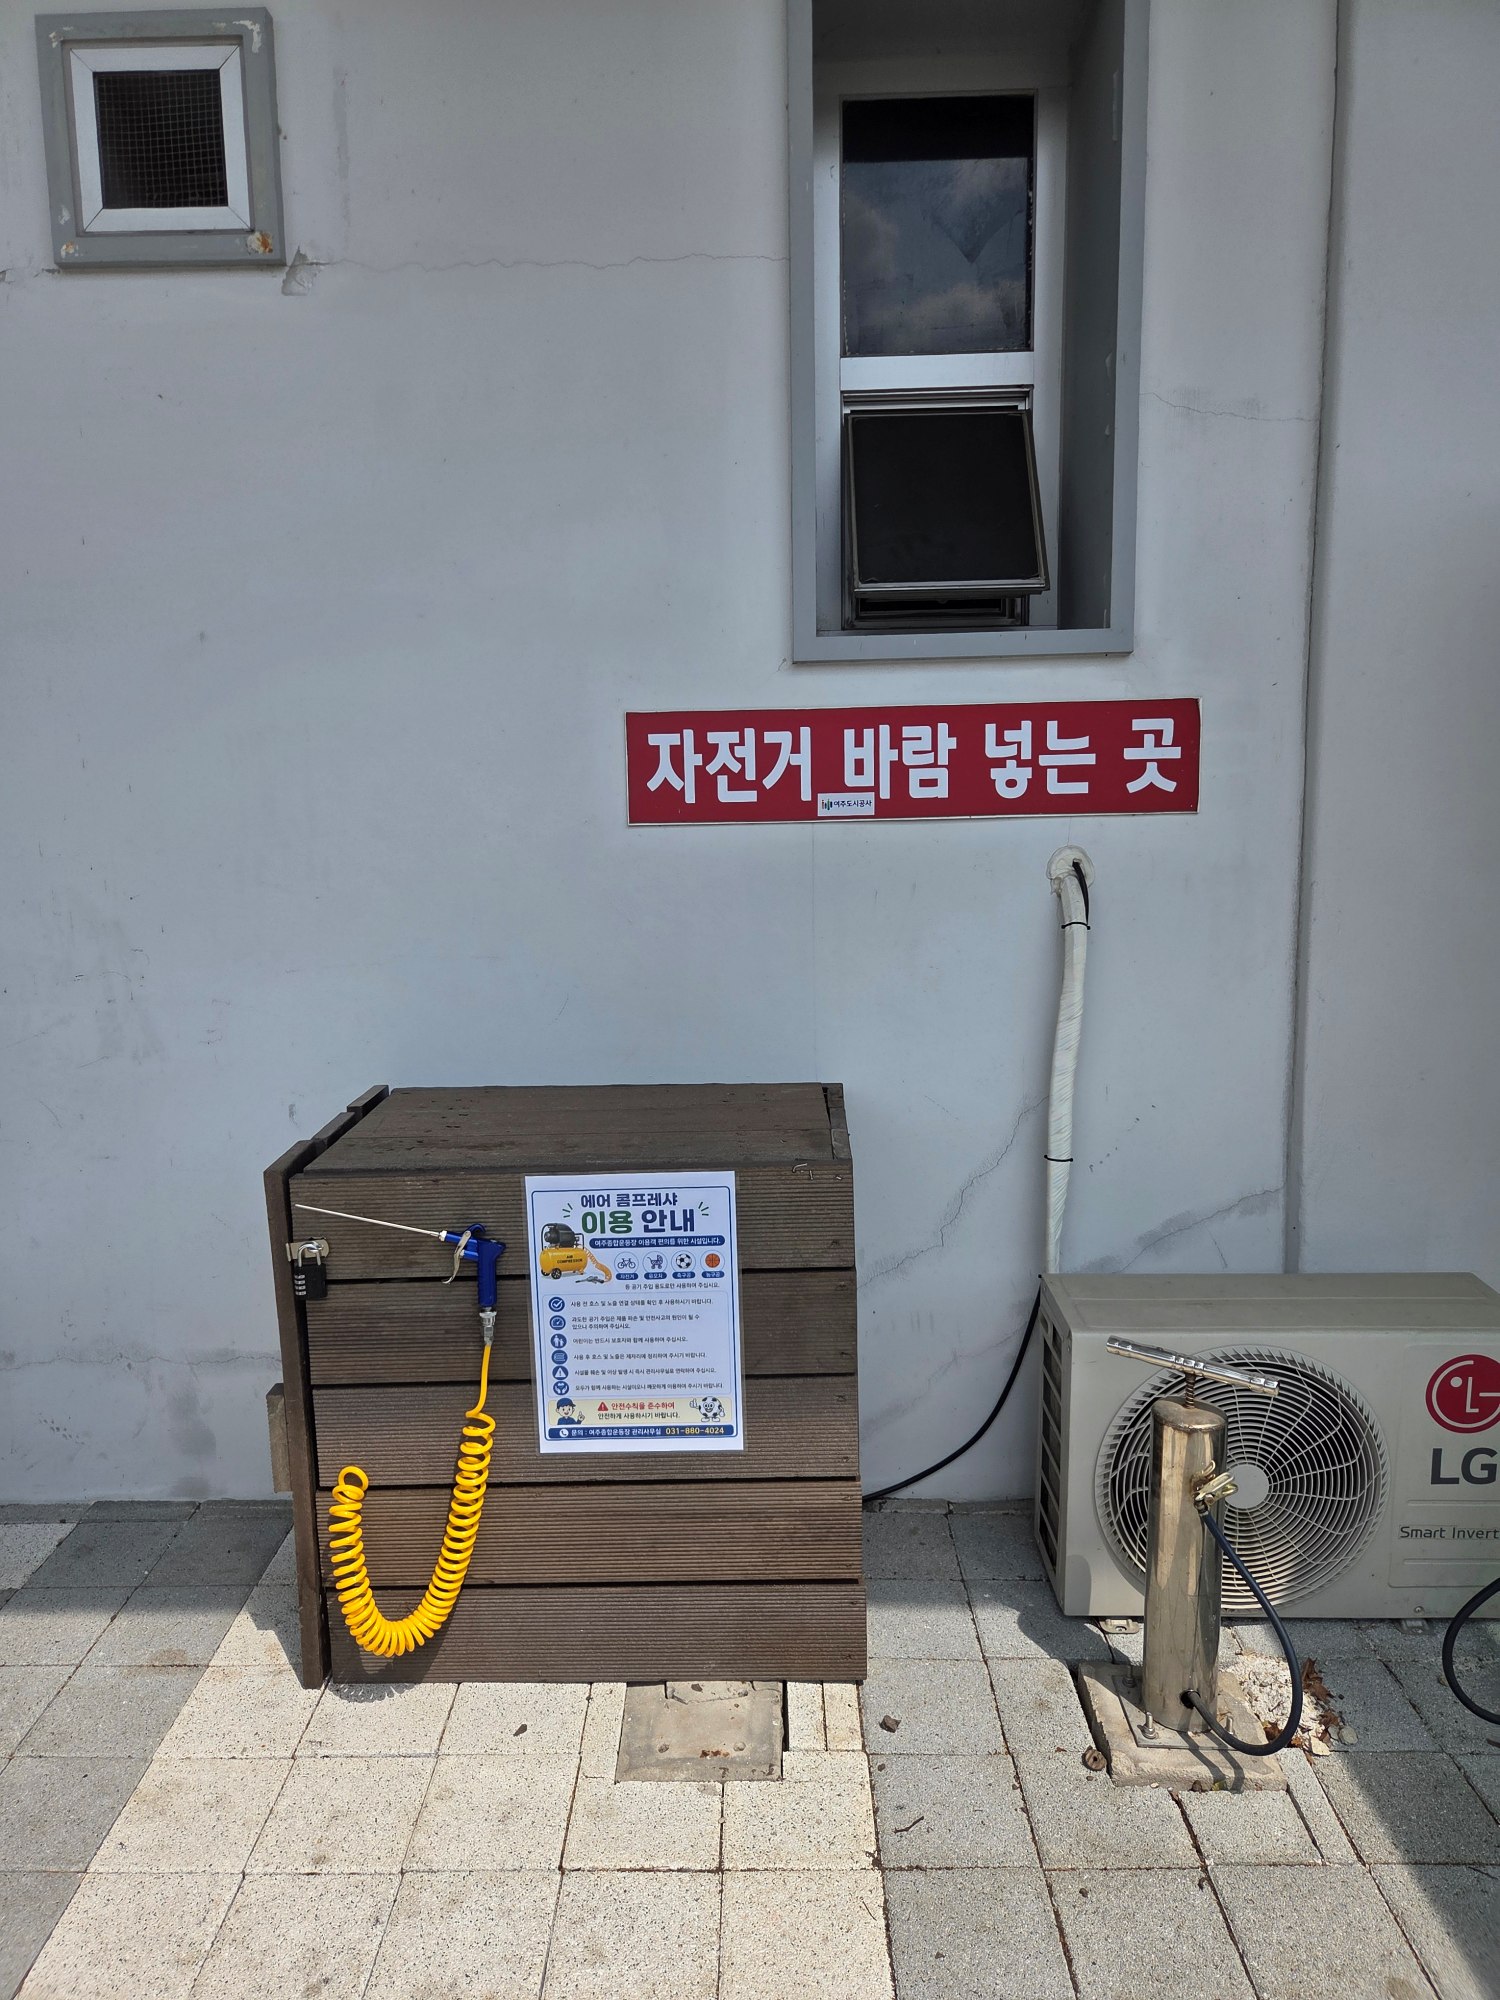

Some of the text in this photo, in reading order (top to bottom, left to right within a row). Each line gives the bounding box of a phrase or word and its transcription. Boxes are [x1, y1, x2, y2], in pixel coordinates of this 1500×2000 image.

[647, 718, 1182, 804] 자전거 바람 넣는 곳
[834, 800, 872, 808] 여주도시공사
[580, 1192, 678, 1208] 에어 콤프레샤
[582, 1209, 694, 1234] 이용 안내
[611, 1401, 675, 1410] 안전수칙을 준수하여
[1430, 1448, 1498, 1485] LG
[1400, 1526, 1446, 1539] Smart
